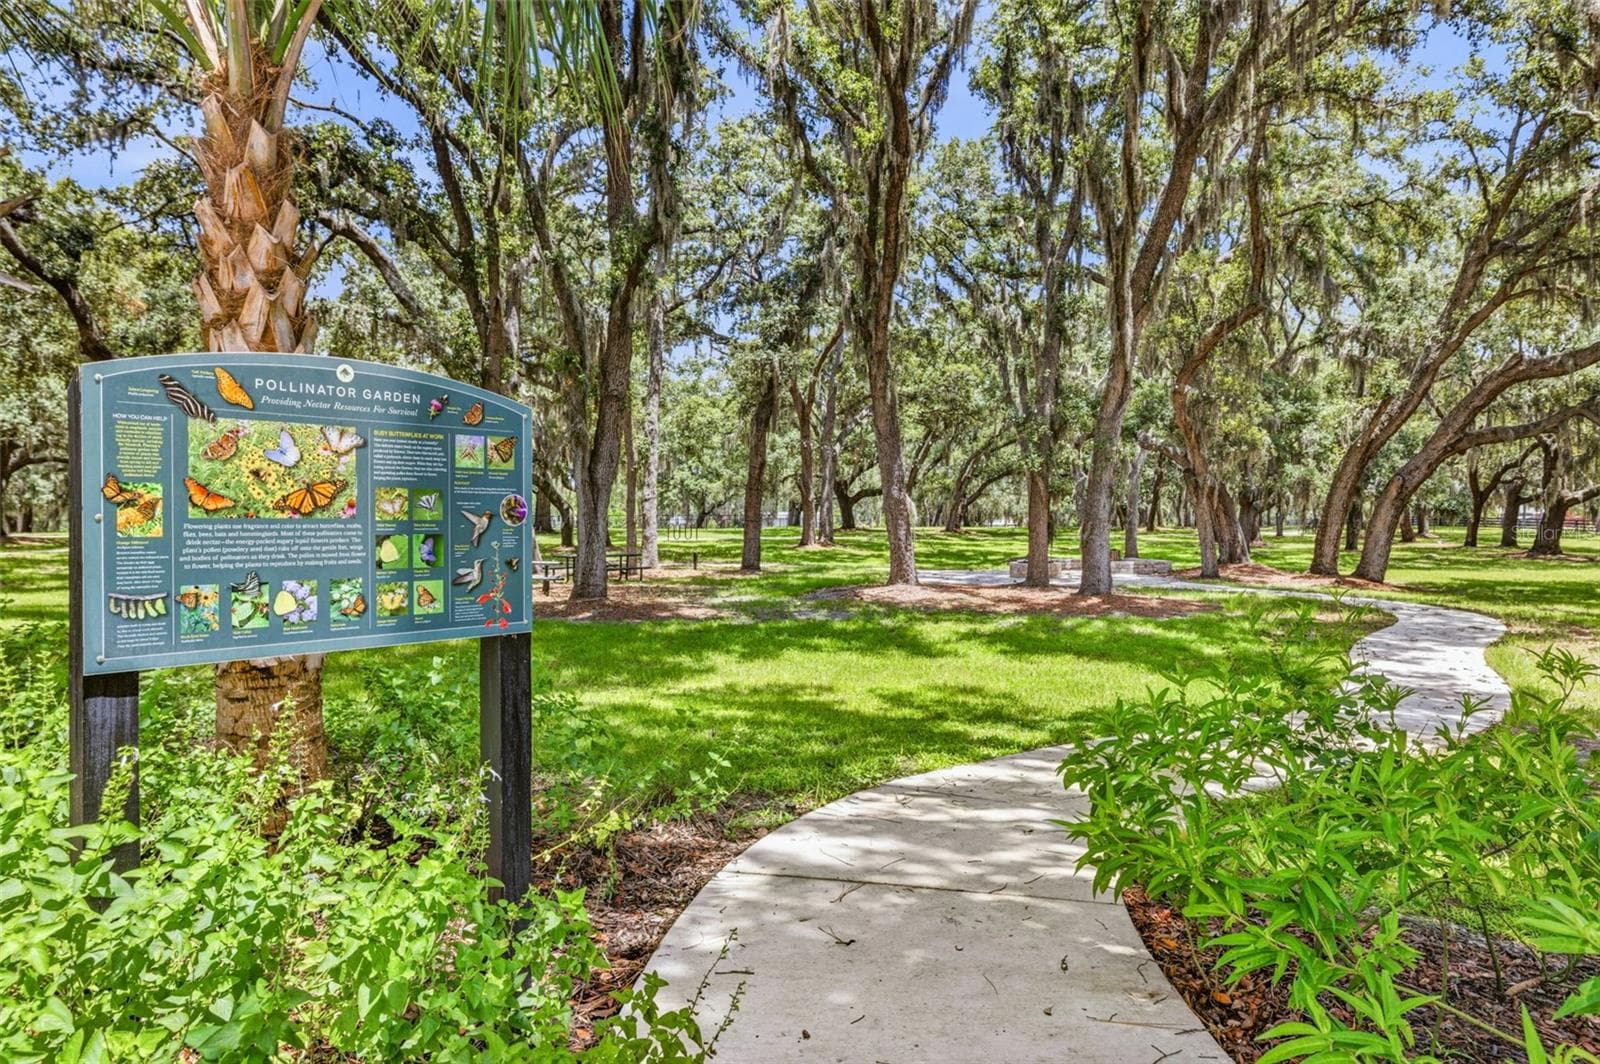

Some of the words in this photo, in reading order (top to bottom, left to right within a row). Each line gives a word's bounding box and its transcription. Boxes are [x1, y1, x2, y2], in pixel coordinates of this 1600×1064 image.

[255, 378, 356, 398] POLLINATOR
[362, 389, 421, 404] GARDEN
[260, 395, 302, 408] Providing
[302, 400, 331, 409] Nectar
[334, 402, 370, 412] Resources
[373, 405, 385, 413] For
[388, 408, 418, 416] Survival
